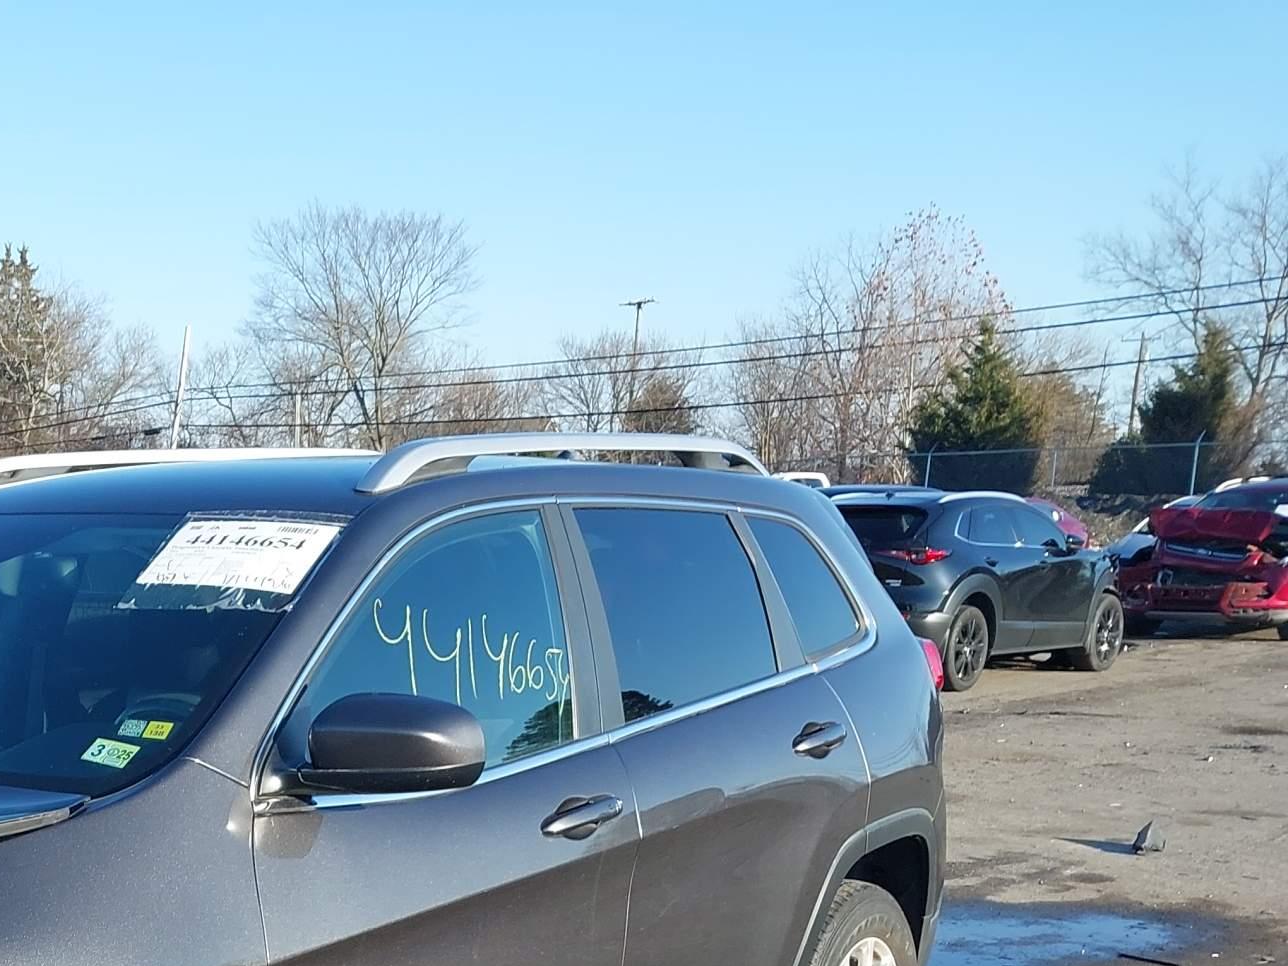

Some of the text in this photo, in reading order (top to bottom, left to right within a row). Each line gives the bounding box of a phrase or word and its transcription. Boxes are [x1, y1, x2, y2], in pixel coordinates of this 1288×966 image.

[186, 534, 306, 550] 44146654
[374, 598, 570, 712] 44146654
[90, 744, 133, 760] 3 25
